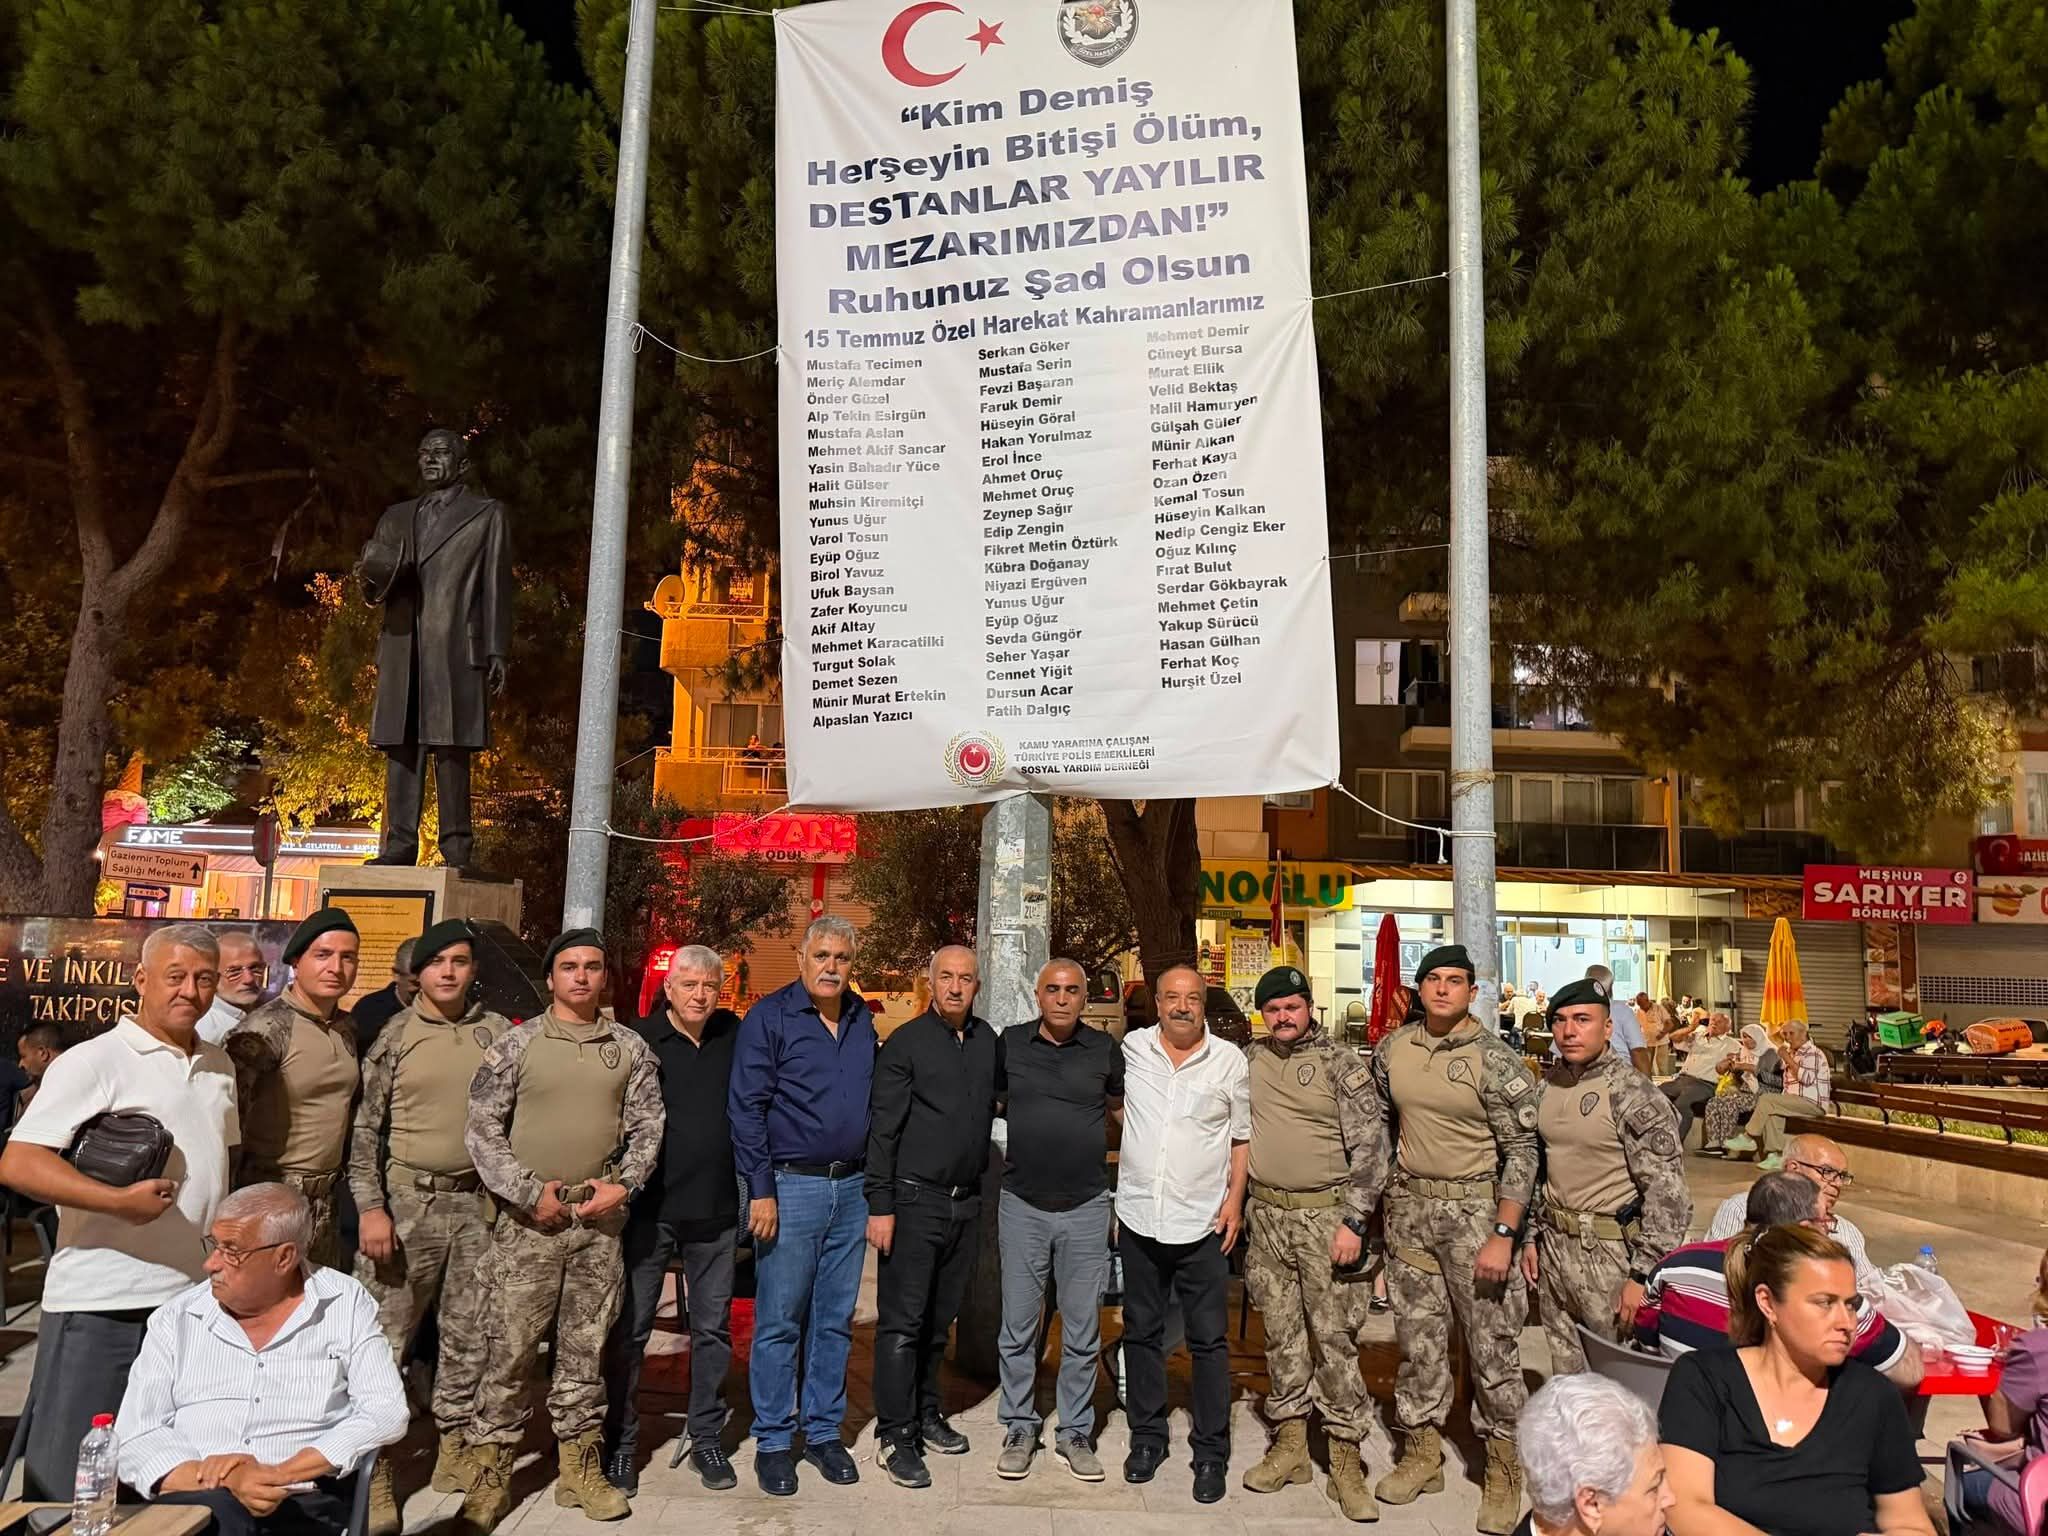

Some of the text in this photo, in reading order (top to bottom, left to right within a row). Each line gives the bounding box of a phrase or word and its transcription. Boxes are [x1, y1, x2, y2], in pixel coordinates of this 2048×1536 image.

[1019, 76, 1154, 116] Demiş
[807, 143, 990, 186] Herşeyin
[1006, 123, 1117, 163] Bitişi
[809, 152, 1265, 228] DESTANLAR YAYILIR
[828, 251, 1251, 314] Ruhunuz Şad Olsun
[804, 295, 1265, 348] 15 Temmuz Özel Harekat Kahramanlarımız
[978, 340, 1071, 360] Serkan Göker
[1147, 344, 1243, 362] Cüneyt Bursa
[978, 357, 1072, 379] Mustafa Serin
[979, 377, 1074, 396] Fevzi Başaran
[1188, 381, 1239, 394] Bektaş
[806, 392, 849, 405] Önder
[980, 394, 1063, 414] Faruk Demir
[807, 411, 829, 425] Alp
[874, 409, 926, 423] Esirgün
[1149, 402, 1182, 415] Halil
[980, 410, 1076, 431] Hüseyin Göral
[1150, 419, 1200, 435] Gülşah
[981, 430, 1093, 450] Hakan Yorulmaz
[981, 450, 1042, 467] Erol İnce
[1152, 450, 1238, 471] Ferhat Kaya
[982, 468, 1063, 485] Ahmet Oruç
[1153, 470, 1227, 489] Ozan Özen
[982, 485, 1075, 503] Mehmet Oruç
[1153, 486, 1245, 508] Kemal Tosun
[982, 502, 1073, 522] Zeynep Sağır
[1154, 503, 1266, 525] Hüseyin Kalkan
[809, 515, 887, 528] Yunus Uğur
[1199, 522, 1249, 537] Cengiz
[1252, 520, 1286, 533] Eker
[809, 532, 889, 546] Varol Tosun
[983, 522, 1064, 540] Edip Zengin
[984, 535, 1119, 557] Fikret Metin Öztürk
[1155, 542, 1238, 560] Oğuz Kılınç
[809, 549, 880, 566] Eyüp Oğuz
[984, 558, 1090, 574] Kübra Doğanay
[809, 567, 885, 582] Birol Yavuz
[1194, 560, 1233, 574] Bulut
[810, 585, 895, 600] Ufuk Baysan
[984, 576, 1087, 594] Niyazi Ergüven
[1156, 576, 1288, 595] Serdar Gökbayrak
[810, 602, 908, 618] Zafer Koyuncu
[984, 594, 1065, 610] Yunus Uğur
[1158, 596, 1259, 614] Mehmet Çetin
[811, 621, 876, 637] Akif Altay
[985, 613, 1059, 630] Eyüp Oğuz
[1158, 615, 1259, 634] Yakup Sürücü
[985, 628, 1083, 645] Sevda Güngör
[1159, 634, 1261, 651] Hasan Gülhan
[811, 636, 945, 655] Mehmet Karacatilki
[812, 655, 896, 673] Turgut Solak
[985, 648, 1071, 664] Seher Yaşar
[1160, 654, 1240, 670] Ferhat Koç
[986, 664, 1073, 681] Cennet Yiğit
[1161, 672, 1242, 690] Hurşit Üzel
[812, 675, 898, 691] Demet Sezen
[986, 684, 1074, 699] Dursun Acar
[812, 690, 947, 709] Münir Murat Ertekin
[986, 703, 1071, 717] Fatih Dalgıç
[812, 711, 913, 729] Alpaslan Yazıcı
[1019, 735, 1150, 750] KAMU YARARINA ÇALIŞAN
[1014, 751, 1060, 762] TÜRKİYE
[1062, 750, 1092, 761] POLİS
[1020, 759, 1150, 775] SOSYAL YARDIM DERNEĞİ
[110, 849, 190, 868] Gaziemir Toplum
[112, 863, 185, 879] Sağlığı Merkezi
[1859, 869, 1923, 883] MEŞHUR
[1813, 882, 1968, 908] SARIYER
[1851, 906, 1928, 922] BÖREKÇİSİ
[22, 958, 53, 984] VE
